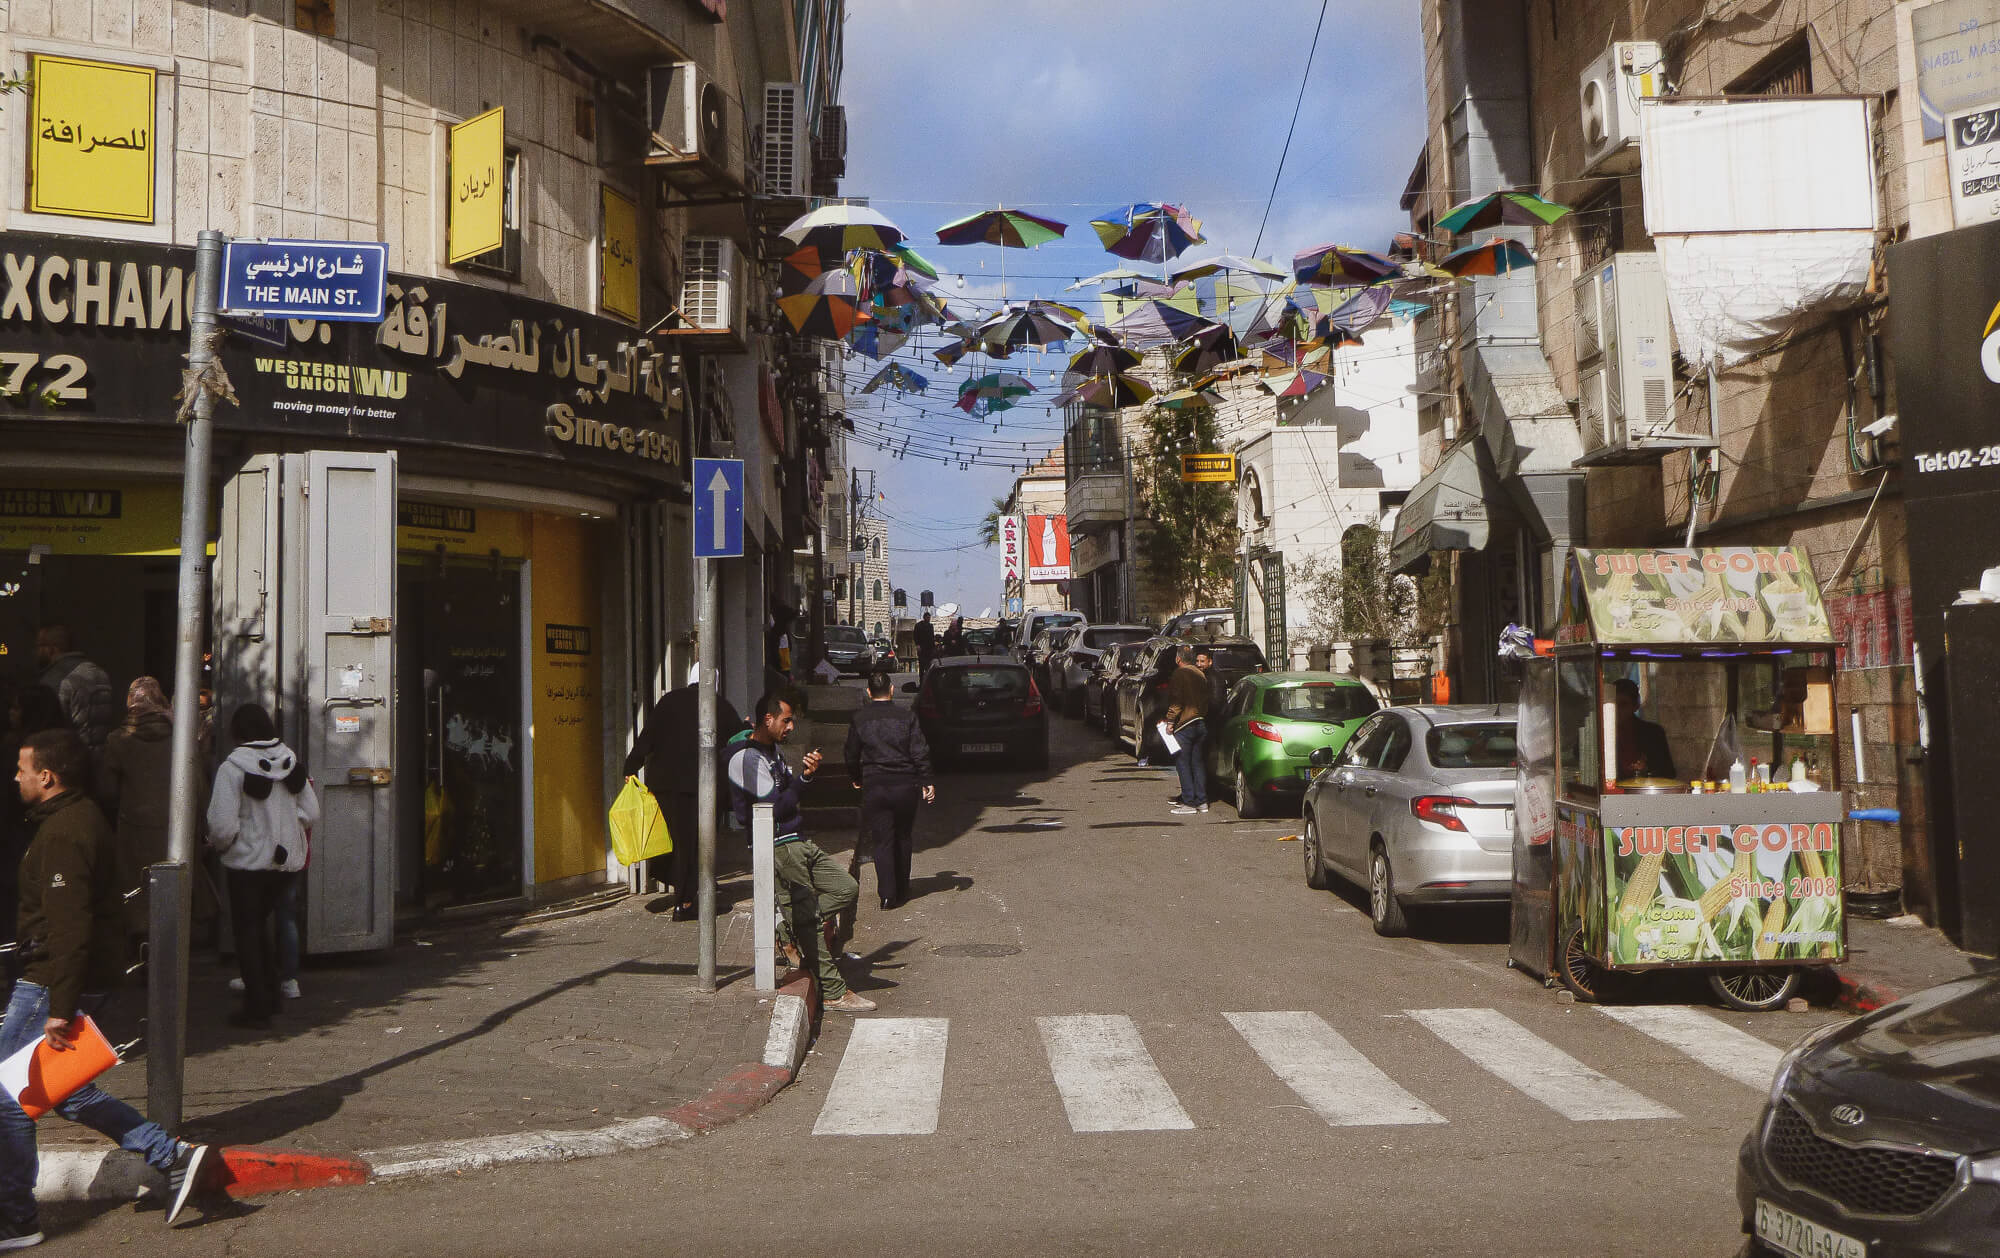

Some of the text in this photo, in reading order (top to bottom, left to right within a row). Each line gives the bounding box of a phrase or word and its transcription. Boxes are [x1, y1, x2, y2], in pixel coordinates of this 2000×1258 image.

[1922, 48, 1963, 72] NABIL
[41, 117, 147, 153] للصرافة
[460, 165, 495, 204] الريان
[245, 253, 364, 280] شارع الرئيسي
[245, 285, 362, 306] THE MAIN ST.
[375, 283, 542, 379] للصرافة
[255, 358, 350, 379] WESTERN
[551, 318, 641, 405] الريان
[286, 375, 350, 393] UNION
[357, 367, 409, 400] WU
[273, 401, 397, 420] moving money for better
[546, 403, 681, 467] Since 1950
[1004, 517, 1017, 581] ARENA
[1594, 552, 1801, 576] SWEET CORN
[1664, 598, 1714, 612] Since
[1619, 824, 1834, 856] SWEET CORN
[1730, 877, 1837, 898] Since 2008
[1650, 909, 1696, 922] CORN
[1657, 947, 1690, 961] CUP
[1834, 1106, 1858, 1124] KIA
